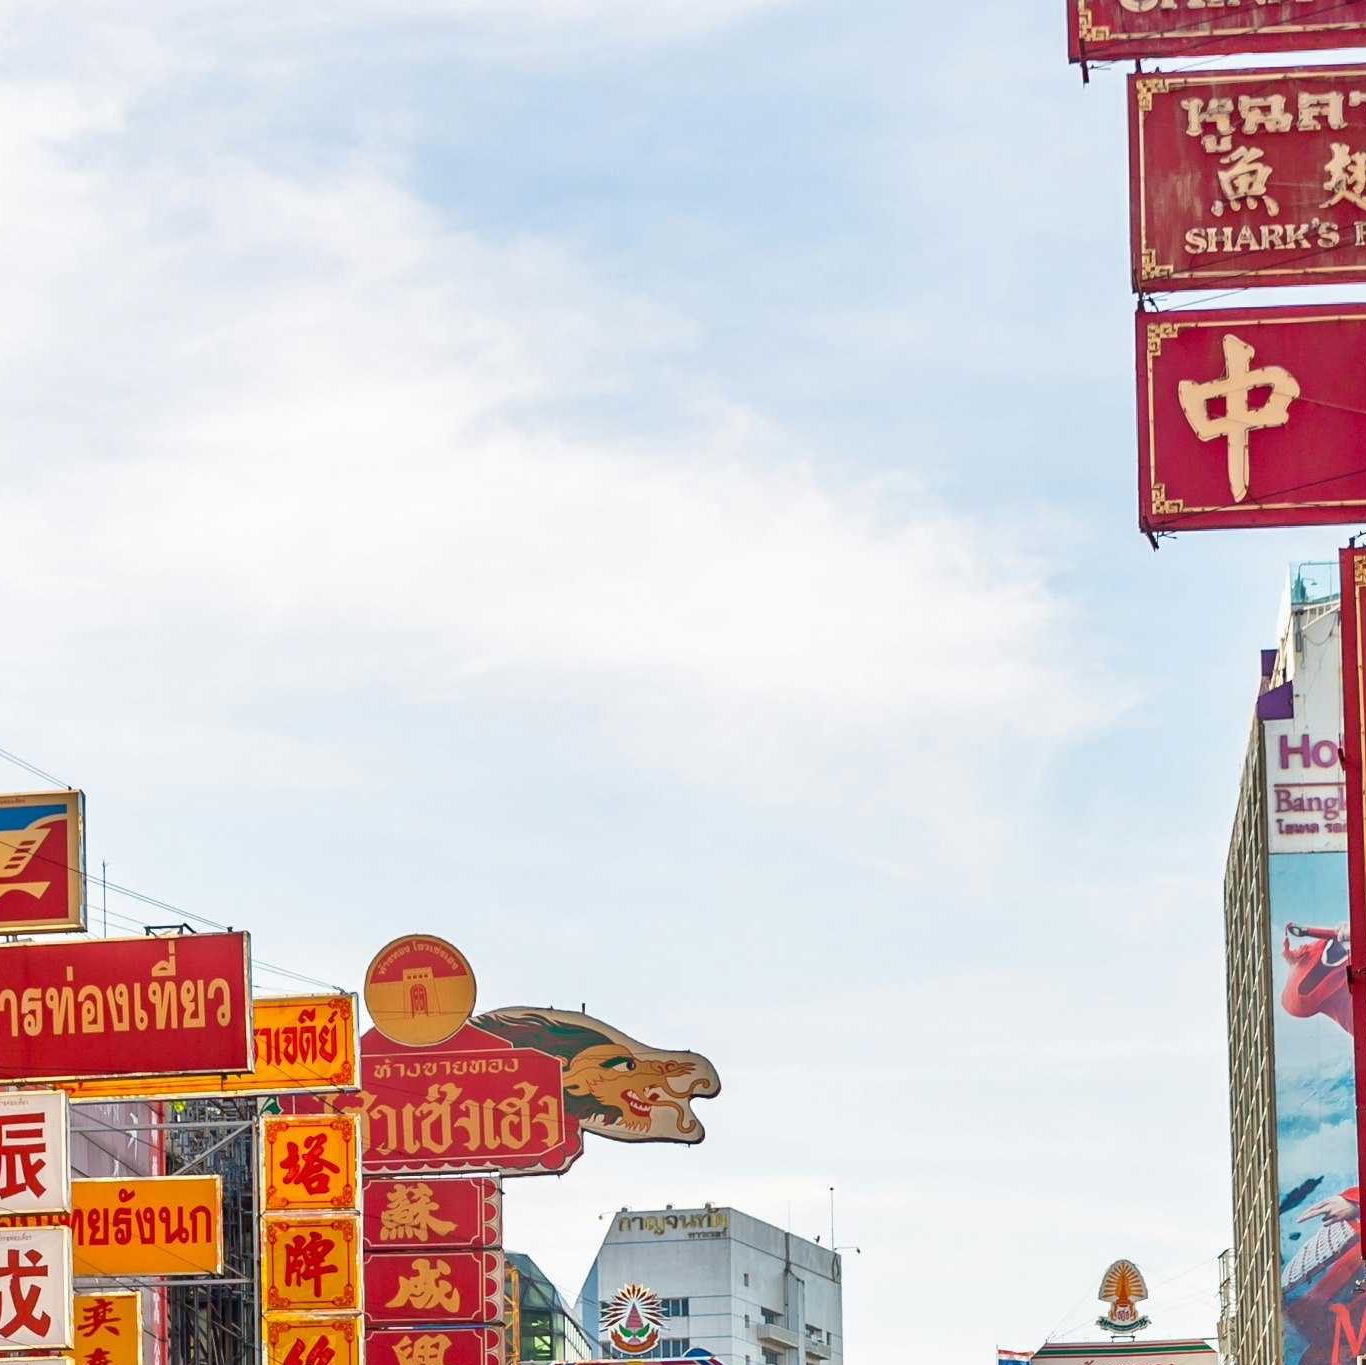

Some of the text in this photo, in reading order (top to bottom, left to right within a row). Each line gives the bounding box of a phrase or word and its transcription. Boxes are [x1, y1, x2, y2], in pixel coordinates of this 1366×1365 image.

[1183, 217, 1340, 255] SHARK'S
[1280, 734, 1344, 769] Ho
[374, 1058, 519, 1079] ห้างขายทอง
